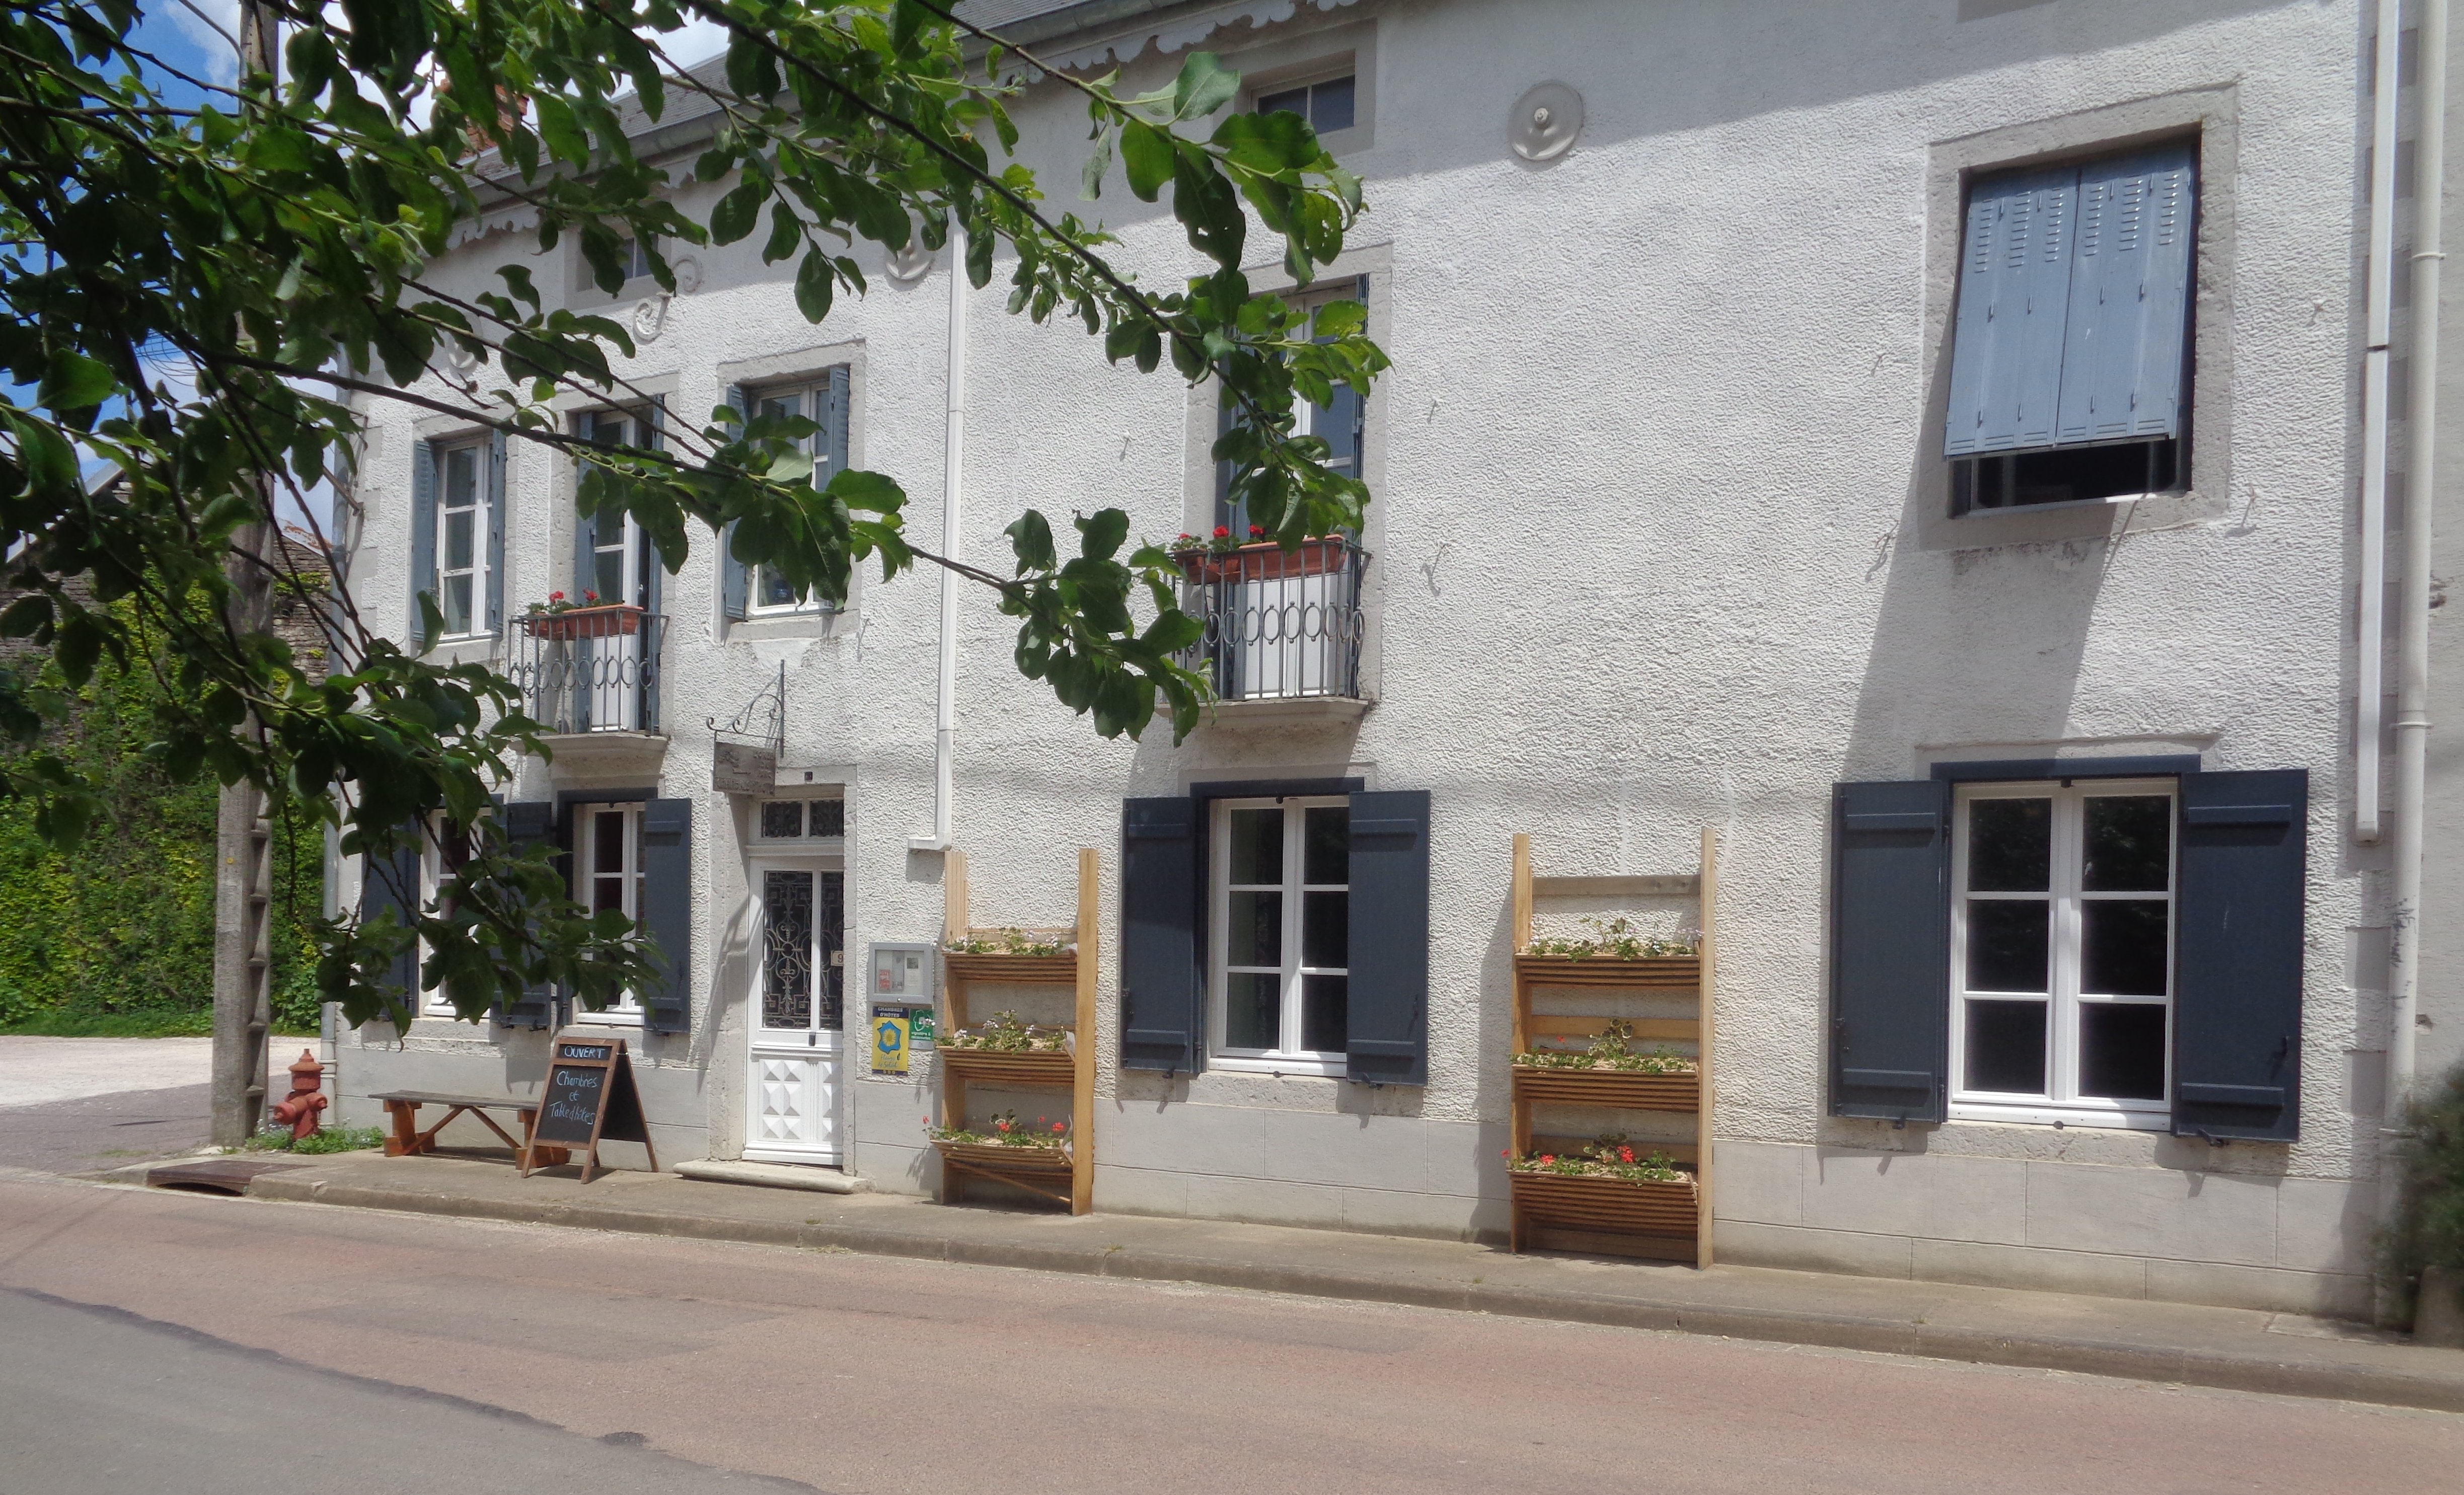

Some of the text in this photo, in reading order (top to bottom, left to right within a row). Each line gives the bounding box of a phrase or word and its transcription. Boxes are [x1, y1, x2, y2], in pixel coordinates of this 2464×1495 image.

[838, 954, 843, 962] 9
[564, 1046, 605, 1059] OUVERT
[569, 1090, 579, 1101] et
